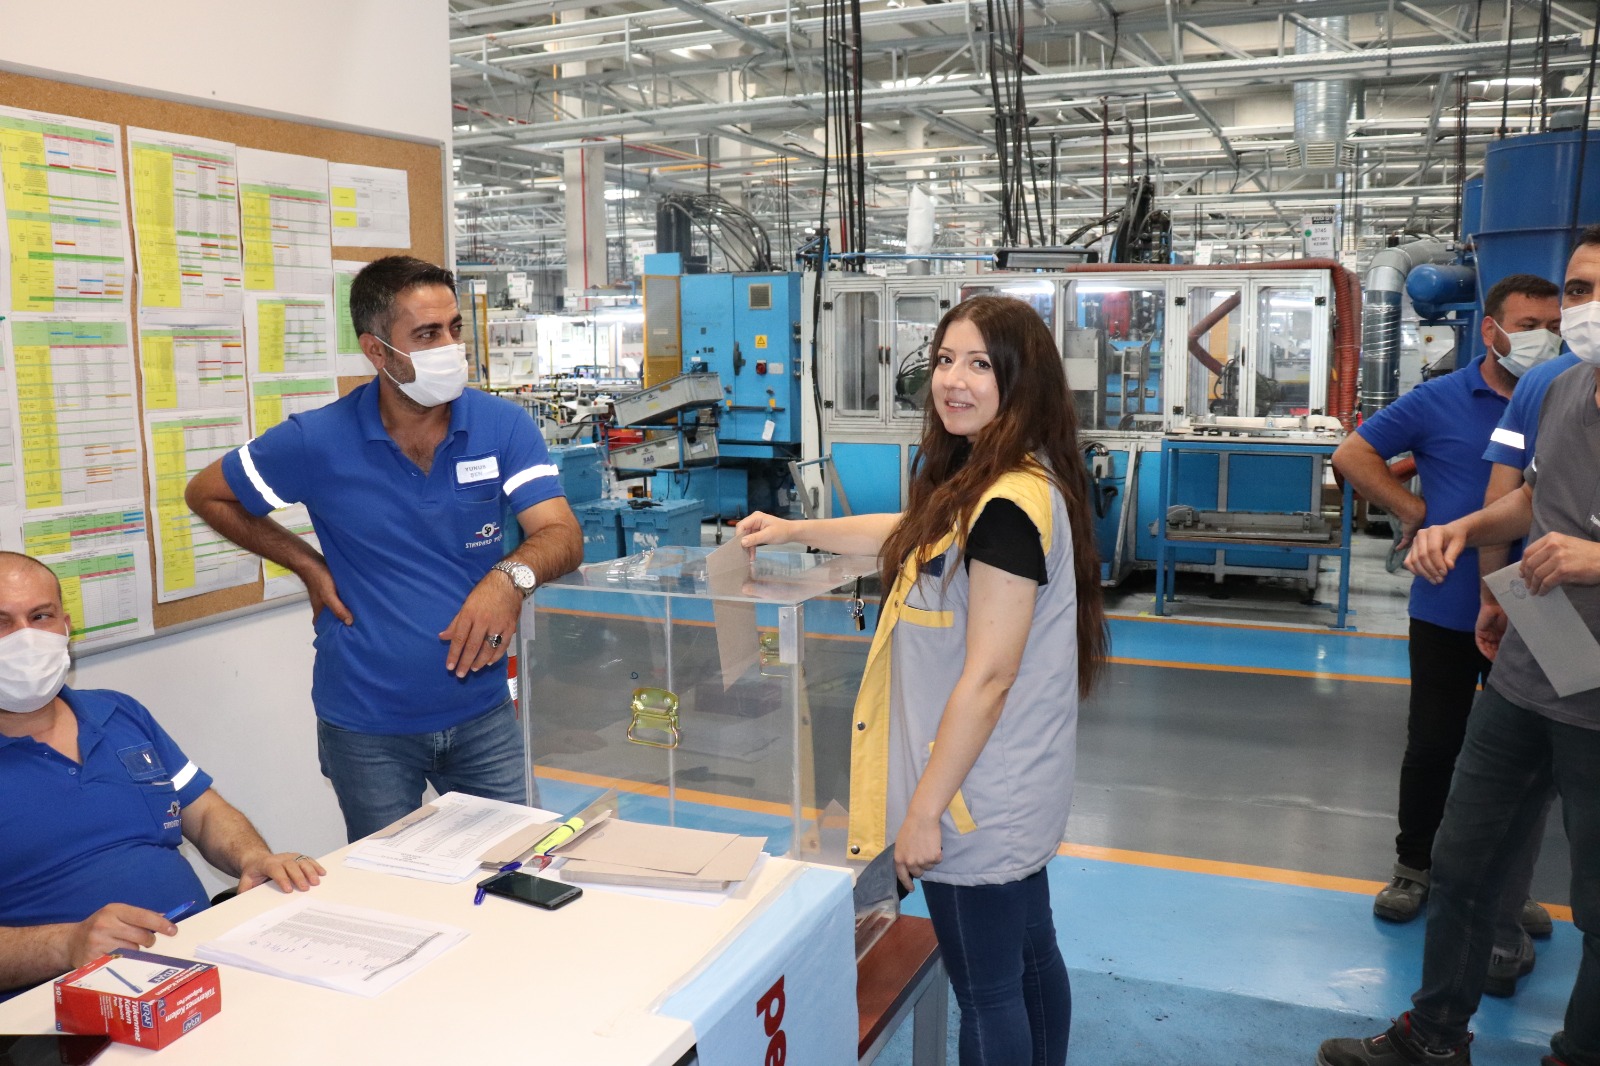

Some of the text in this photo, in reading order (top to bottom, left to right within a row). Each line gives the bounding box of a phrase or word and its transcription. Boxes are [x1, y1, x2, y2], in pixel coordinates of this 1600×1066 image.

[465, 538, 493, 549] STANDARD
[153, 969, 176, 984] KRAF
[185, 986, 216, 1010] Tükenmez
[124, 998, 132, 1025] Kalem
[131, 1000, 141, 1042] Tükenmez
[142, 1003, 152, 1027] KRAF
[165, 1005, 186, 1023] Kalem
[184, 1015, 200, 1031] KRAF
